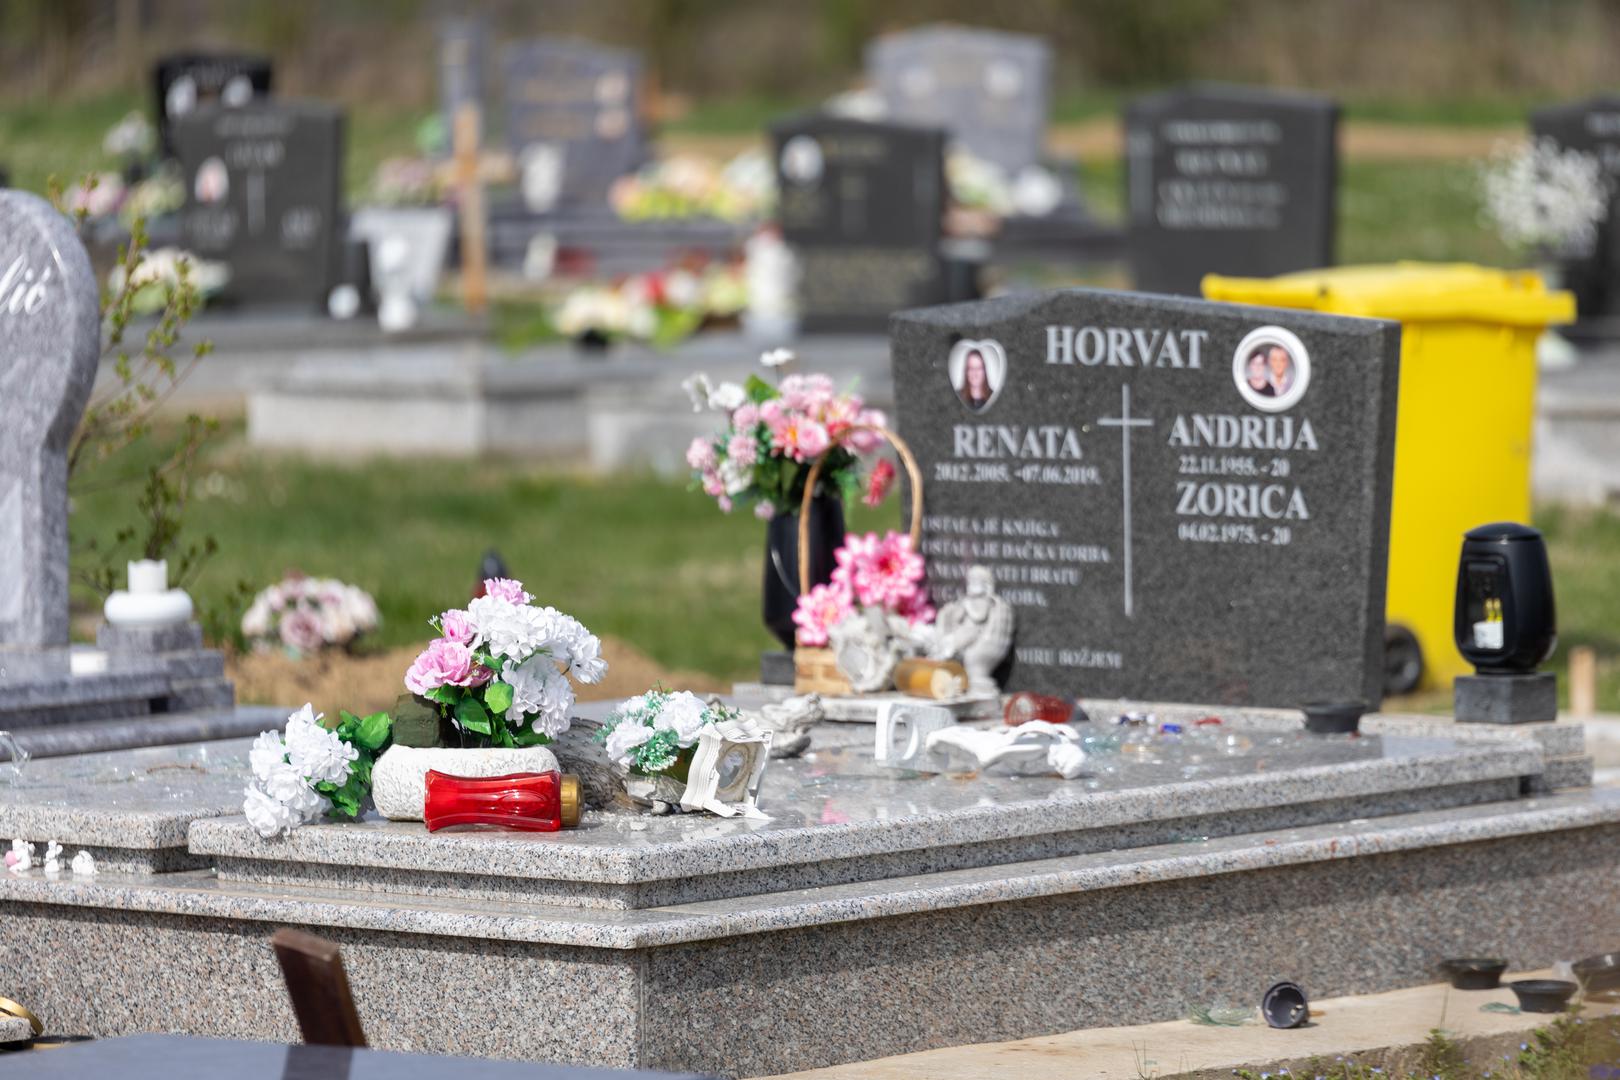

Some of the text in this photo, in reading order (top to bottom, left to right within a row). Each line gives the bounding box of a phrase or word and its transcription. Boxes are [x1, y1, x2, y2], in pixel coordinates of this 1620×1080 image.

[1045, 325, 1209, 369] HORVAT
[953, 424, 1083, 460] RENATA
[1168, 414, 1319, 451] ANDRIJA
[1176, 480, 1310, 520] ZORICA
